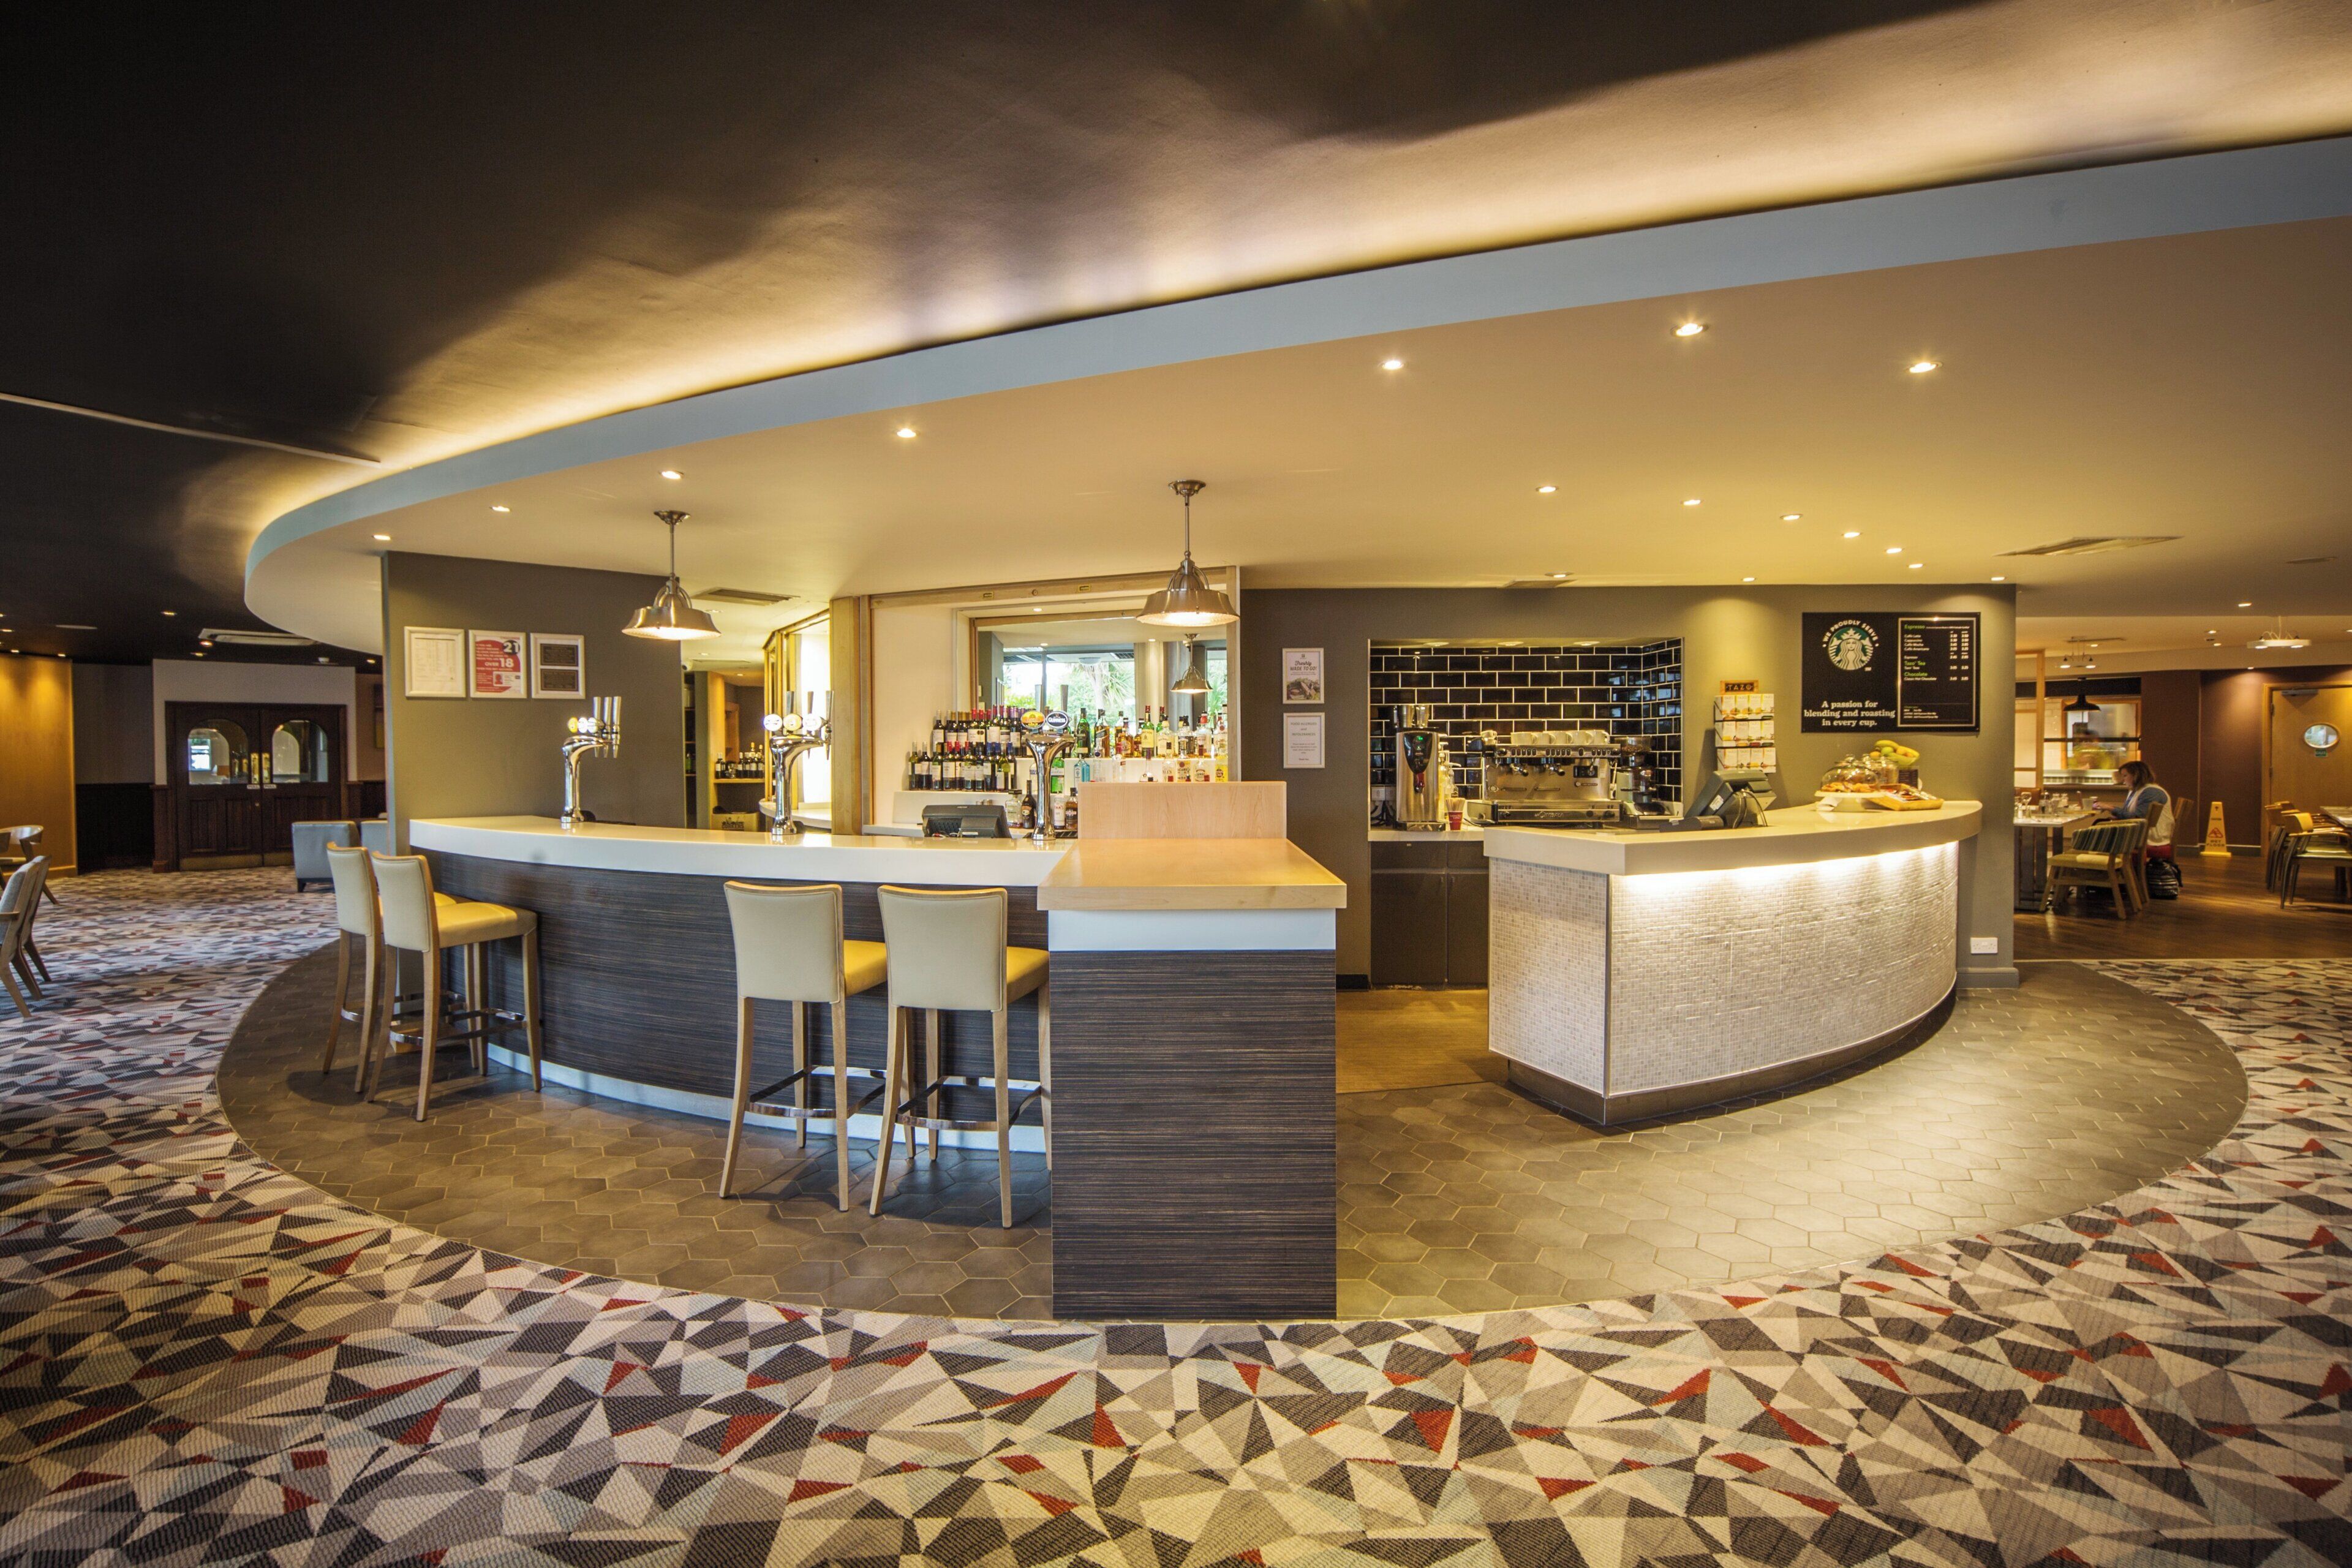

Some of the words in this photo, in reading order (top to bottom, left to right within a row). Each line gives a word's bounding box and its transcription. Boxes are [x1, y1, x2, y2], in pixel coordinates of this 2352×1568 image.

[1823, 631, 1832, 642] WE
[1830, 619, 1861, 632] PROUDLY
[1861, 623, 1879, 641] SERVE
[503, 641, 520, 654] 21
[500, 658, 514, 668] 18
[1831, 700, 1863, 709] passion
[1803, 709, 1841, 718] blending
[1860, 709, 1896, 718] roasting
